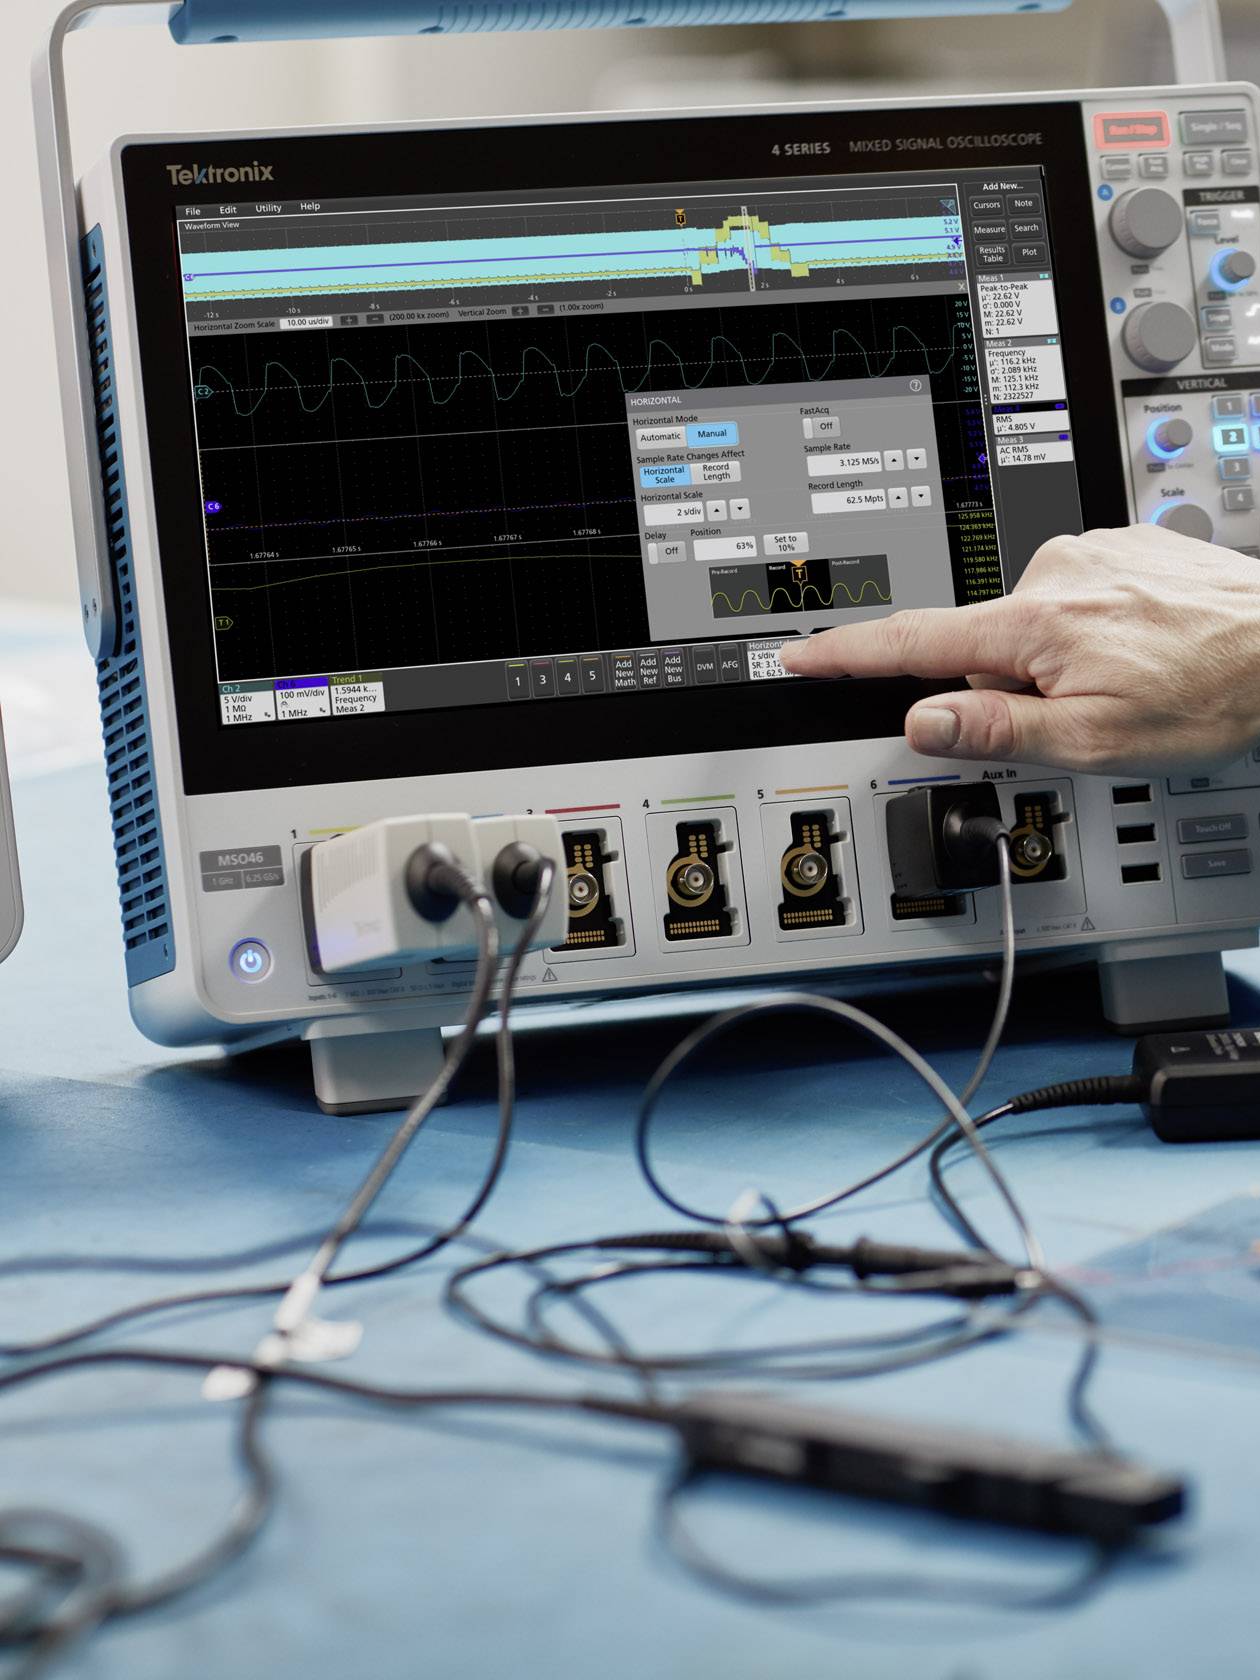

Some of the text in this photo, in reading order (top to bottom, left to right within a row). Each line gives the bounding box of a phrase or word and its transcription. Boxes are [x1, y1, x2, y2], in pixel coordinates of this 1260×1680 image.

[850, 133, 1044, 152] MIXED SIGNAL OSCILLOSCOPE
[771, 142, 831, 156] 4 SERIES
[166, 161, 275, 186] Tektronix
[982, 182, 998, 190] Add
[255, 203, 282, 214] Utility
[300, 202, 321, 213] Help
[973, 201, 1001, 209] Cursors
[185, 207, 201, 216] File
[219, 206, 237, 215] Edit
[184, 221, 240, 231] Waveform View
[974, 225, 1006, 234] Measure
[1014, 224, 1039, 232] Search
[979, 246, 1005, 254] Results
[1022, 248, 1037, 256] Plot
[983, 254, 1004, 262] Table
[981, 283, 1028, 292] Peak-to-Peak
[559, 302, 604, 312] (1.00x zoom)
[389, 313, 416, 322] (200.00
[427, 311, 450, 320] zoom)
[458, 308, 507, 317] Vertical Zoom
[193, 318, 330, 332] Horizontal Zoom Scale 10.00 us/div
[988, 349, 1026, 359] Frequency
[1177, 378, 1228, 391] VERTICAL
[630, 396, 683, 406] HORIZONTAL
[800, 407, 830, 416] FastAcq
[1143, 403, 1183, 414] Position
[632, 414, 698, 426] Horizontal Mode
[819, 422, 833, 430] Off
[640, 432, 681, 442] Automatic
[697, 429, 728, 438] Manual
[804, 444, 832, 454] Sample
[636, 450, 746, 465] Sample Rate Changes Affect
[840, 457, 880, 467] 3.125 MS/s
[643, 466, 685, 476] Horizontal
[702, 463, 730, 471] Record
[655, 475, 675, 484] Scale
[703, 472, 731, 482] Length
[808, 479, 863, 490] Record Length
[641, 491, 703, 502] Horizontal Scale
[1161, 487, 1185, 498] Scale
[846, 495, 884, 504] 62.5 Mpts
[677, 507, 701, 516] 2 s/div
[644, 532, 667, 541] Delay
[690, 527, 721, 537] Position
[774, 535, 787, 543] Set
[665, 547, 678, 555] Off
[736, 542, 754, 551] 63%
[779, 544, 796, 552] 10%
[615, 660, 632, 668] Add
[640, 658, 657, 666] Add
[664, 656, 681, 664] Add
[664, 665, 683, 673] New
[696, 662, 714, 671] DVM
[722, 661, 738, 669] AFG
[752, 661, 765, 669] SR:
[615, 670, 634, 678] New
[640, 667, 659, 675] New
[615, 678, 636, 687] Math
[643, 676, 657, 684] Ref
[667, 675, 682, 683] Bus
[280, 689, 325, 699] 100 mV/div
[335, 695, 377, 705] Frequency
[982, 768, 1017, 781] Aux In
[870, 779, 878, 790] 6
[757, 789, 765, 800] 5
[642, 799, 651, 809] 4
[218, 851, 264, 867] MSO46
